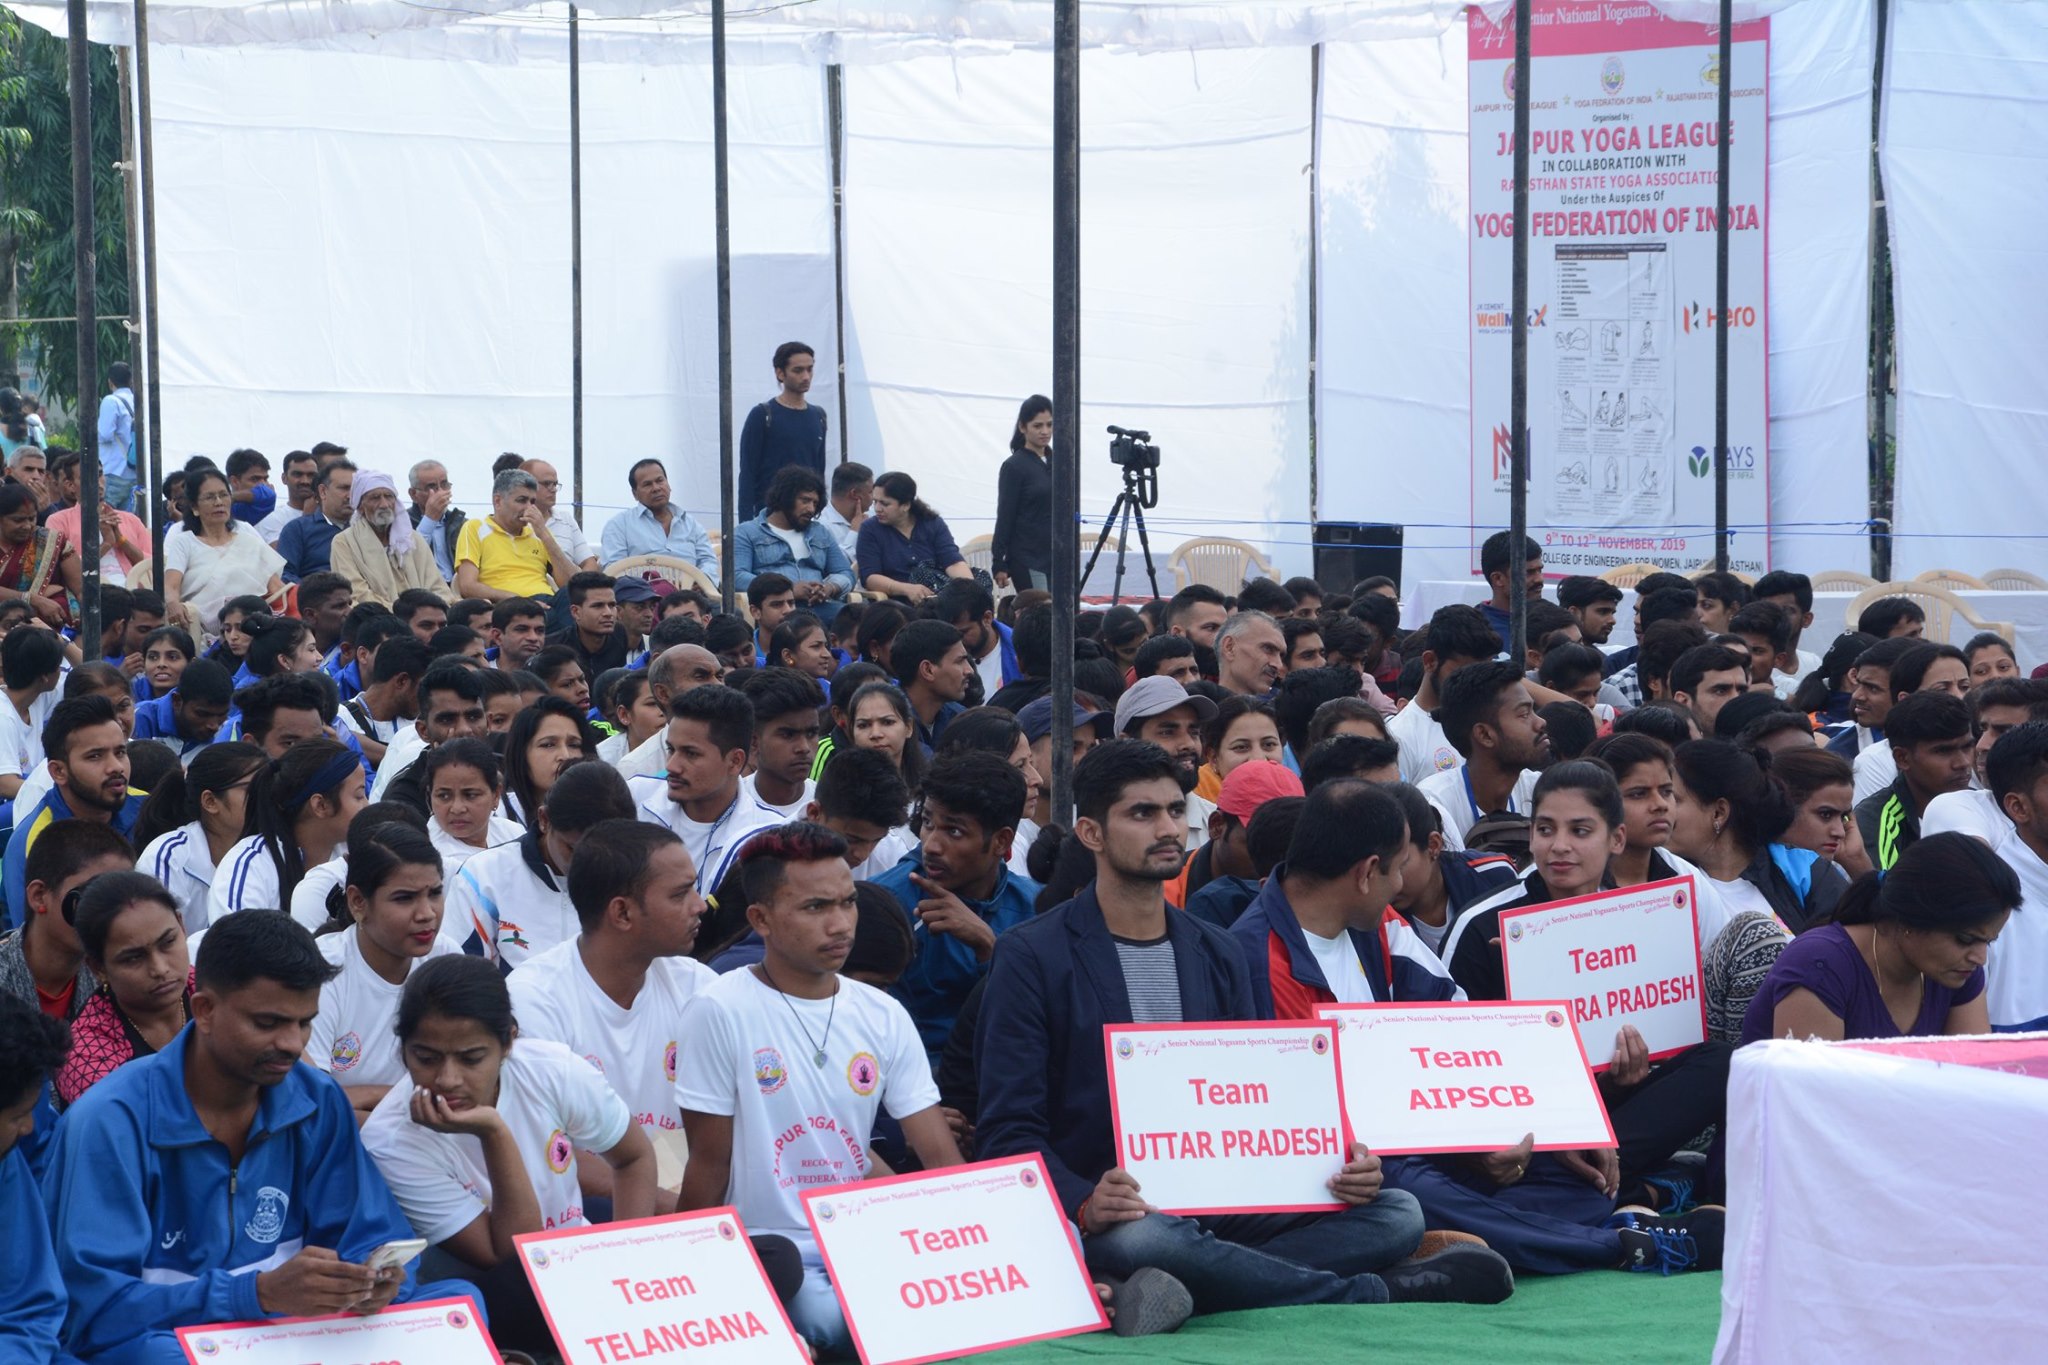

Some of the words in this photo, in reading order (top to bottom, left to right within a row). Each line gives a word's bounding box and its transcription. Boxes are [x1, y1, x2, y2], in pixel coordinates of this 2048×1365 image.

[1530, 8, 1554, 27] enior
[1556, 4, 1600, 25] National
[1604, 3, 1651, 25] Yogasana
[1473, 104, 1500, 113] JAIPUR
[1503, 102, 1514, 111] YO
[1530, 101, 1558, 110] EAGUE
[1574, 99, 1589, 108] YOGA
[1626, 97, 1634, 105] OF
[1636, 96, 1652, 104] INDIA
[1667, 93, 1697, 102] RAJASTHAN
[1697, 92, 1714, 100] STATE
[1497, 130, 1575, 156] JPUR
[1581, 126, 1641, 153] YOGA
[1542, 160, 1555, 173] IN
[1558, 155, 1651, 172] COLLABORATION
[1654, 153, 1686, 168] WITH
[1501, 178, 1567, 192] RASTHAN
[1571, 176, 1607, 190] STATE
[1610, 174, 1642, 188] YOGA
[1645, 171, 1718, 186] ASSOCIATIO
[1561, 194, 1588, 205] Under
[1591, 193, 1606, 204] the
[1609, 191, 1651, 205] Auspices
[1653, 190, 1665, 201] Of
[1474, 211, 1514, 238] YOG
[1532, 208, 1657, 237] FEDERATION
[1663, 206, 1691, 233] OF
[1696, 203, 1760, 232] INDIA
[1713, 446, 1754, 468] AYS
[1561, 534, 1574, 547] TO
[1599, 536, 1657, 552] NOVEMBER,
[1661, 538, 1686, 551] 2019
[1543, 552, 1570, 565] OLLEGE
[1573, 554, 1582, 565] OF
[1584, 554, 1632, 568] ENGINEERING
[1729, 560, 1764, 574] ASTHAN)
[1569, 909, 1593, 921] National
[1618, 902, 1635, 912] Sports
[1636, 896, 1671, 907] Championship
[1568, 943, 1637, 975] Team
[1607, 974, 1696, 1017] PRADESH
[1438, 1014, 1470, 1022] Yogasana
[1471, 1014, 1494, 1022] Sports
[1494, 1013, 1542, 1021] Championship
[1167, 1039, 1188, 1048] Senior
[1190, 1038, 1217, 1047] National
[1247, 1037, 1266, 1048] Sports
[1267, 1036, 1309, 1046] Championship
[1410, 1047, 1503, 1069] Team
[1188, 1078, 1269, 1105] Team
[1410, 1085, 1534, 1111] AIPSCB
[1128, 1132, 1216, 1162] UTTAR
[1222, 1127, 1339, 1158] PRADESH
[797, 1174, 838, 1184] FEDERA
[900, 1223, 989, 1255] Team
[612, 1274, 696, 1305] Team
[900, 1264, 1030, 1309] ODISHA
[363, 1322, 388, 1331] Sports
[585, 1311, 769, 1364] TELANGANA
